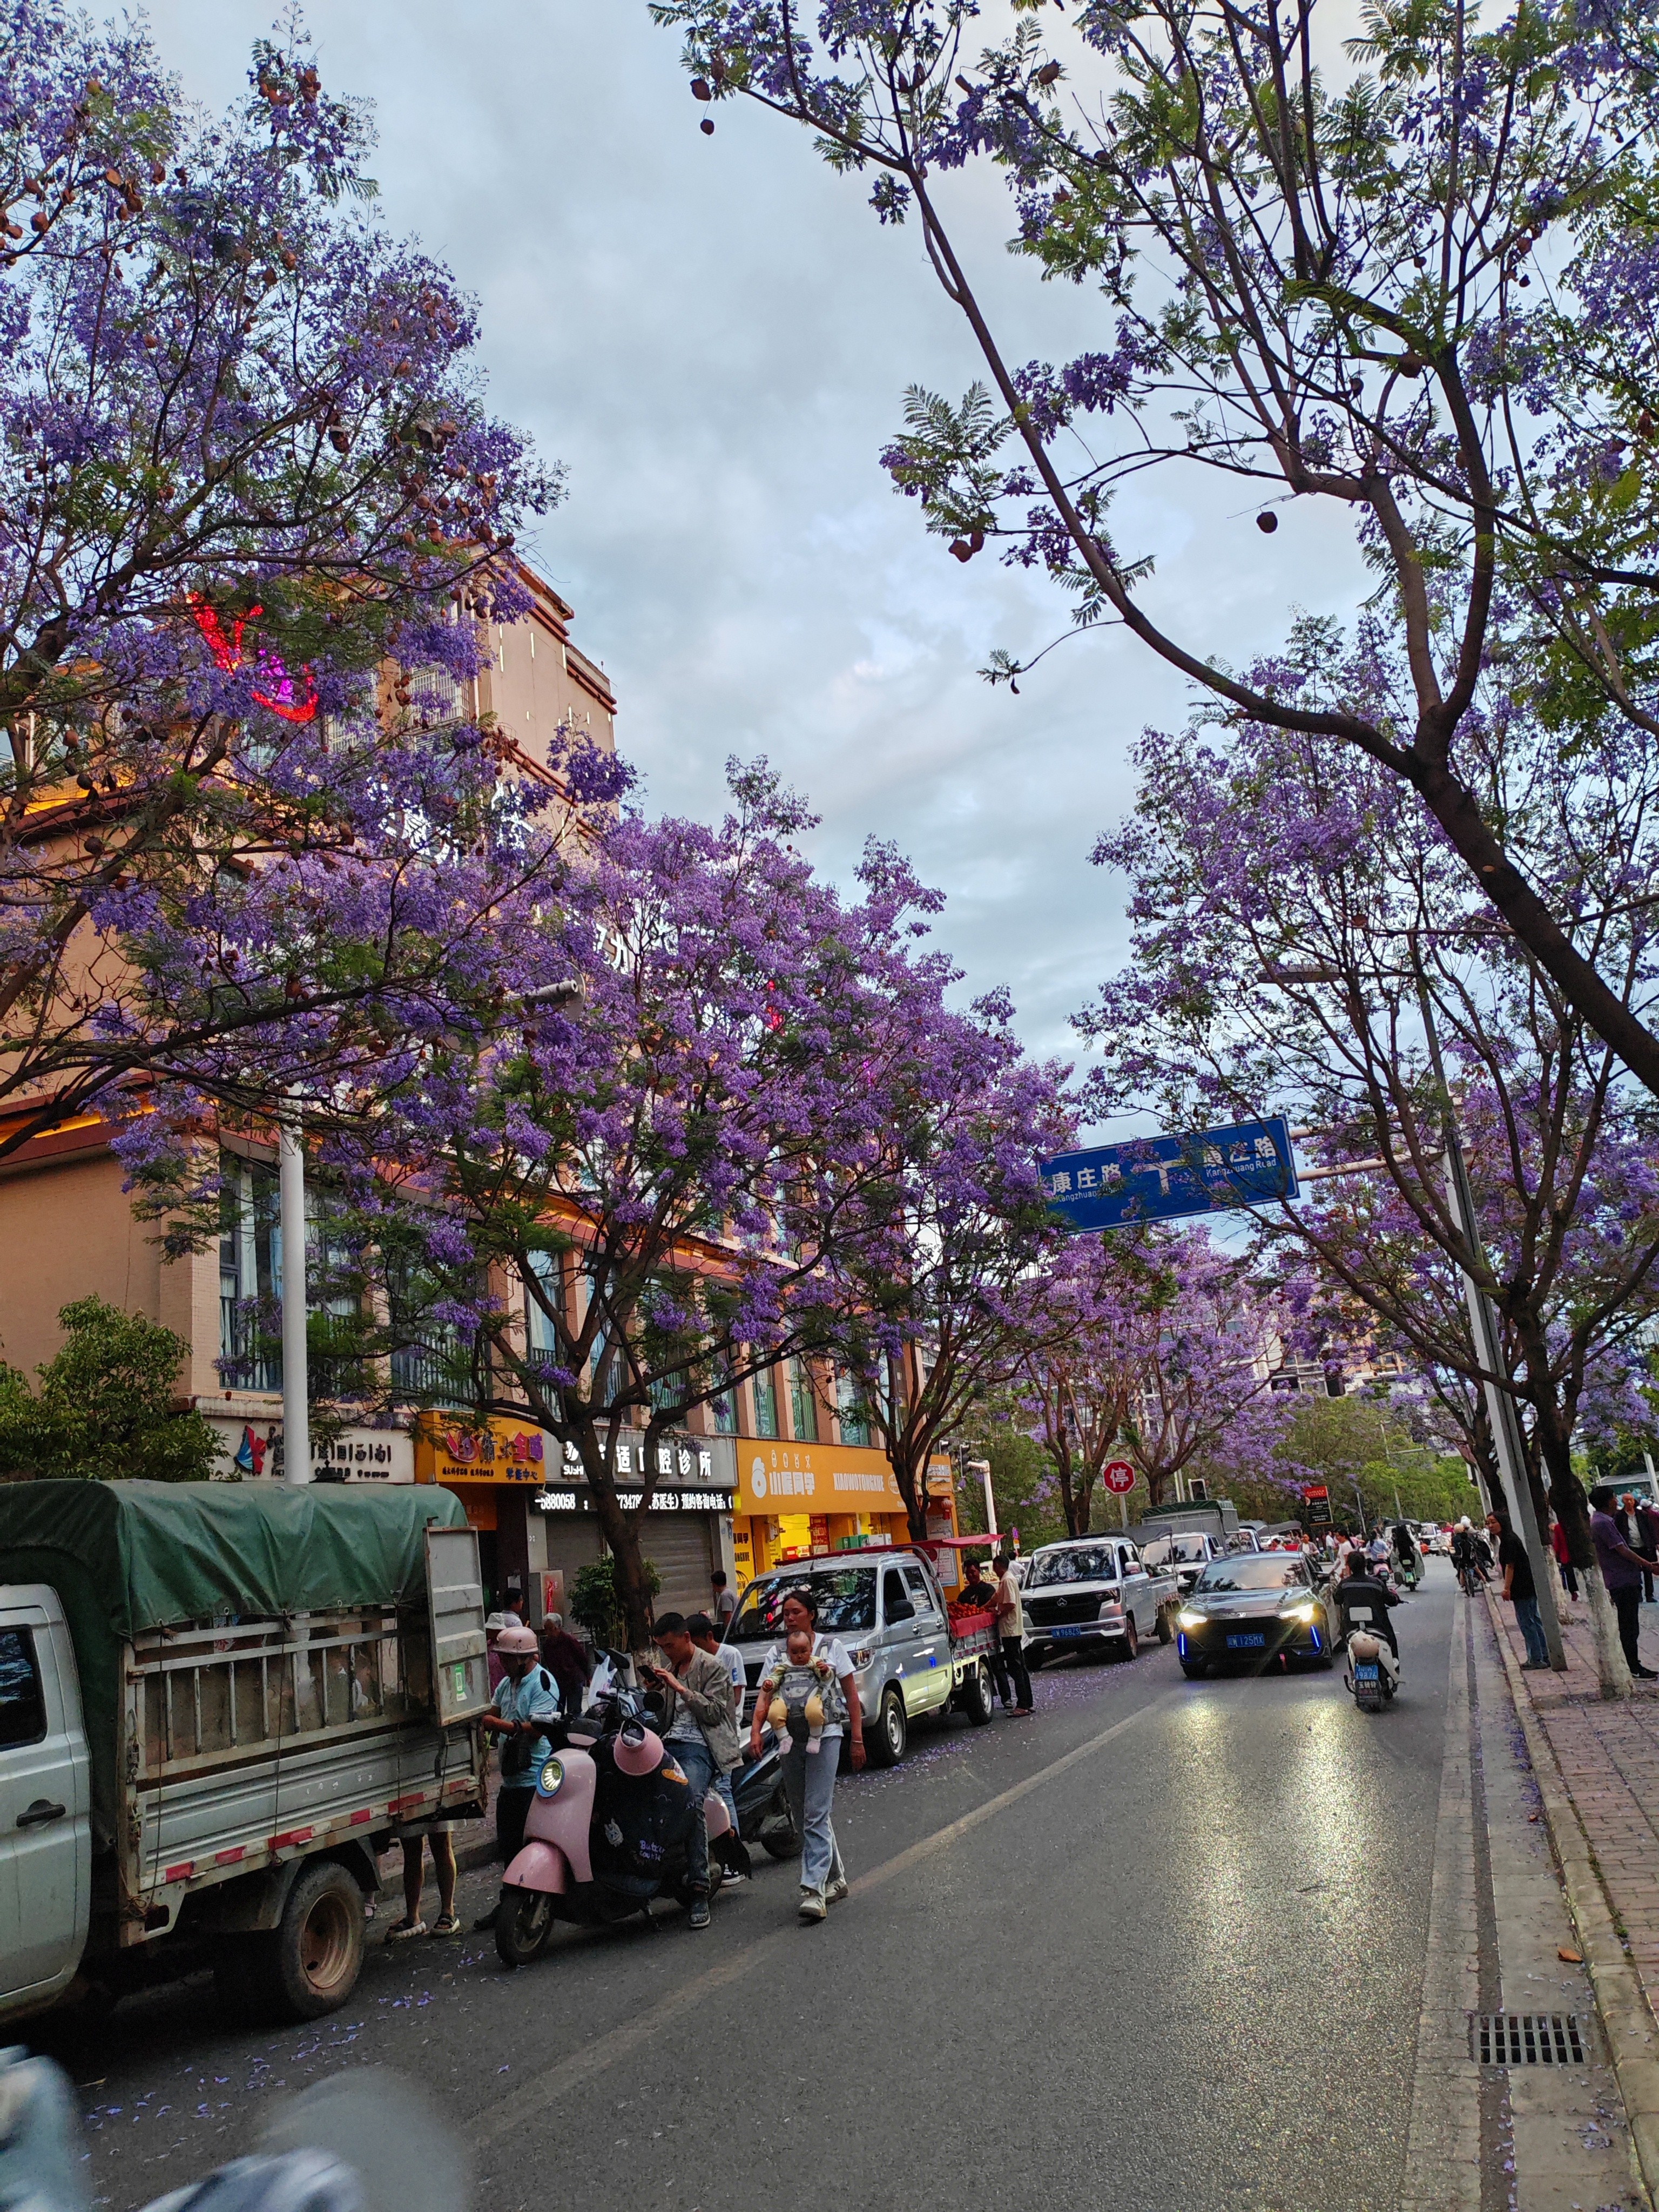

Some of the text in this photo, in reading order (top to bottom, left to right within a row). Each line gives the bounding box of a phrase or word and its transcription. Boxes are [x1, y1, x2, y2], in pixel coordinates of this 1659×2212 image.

[1051, 1163, 1122, 1195] 康庄路
[1110, 1467, 1129, 1488] 停
